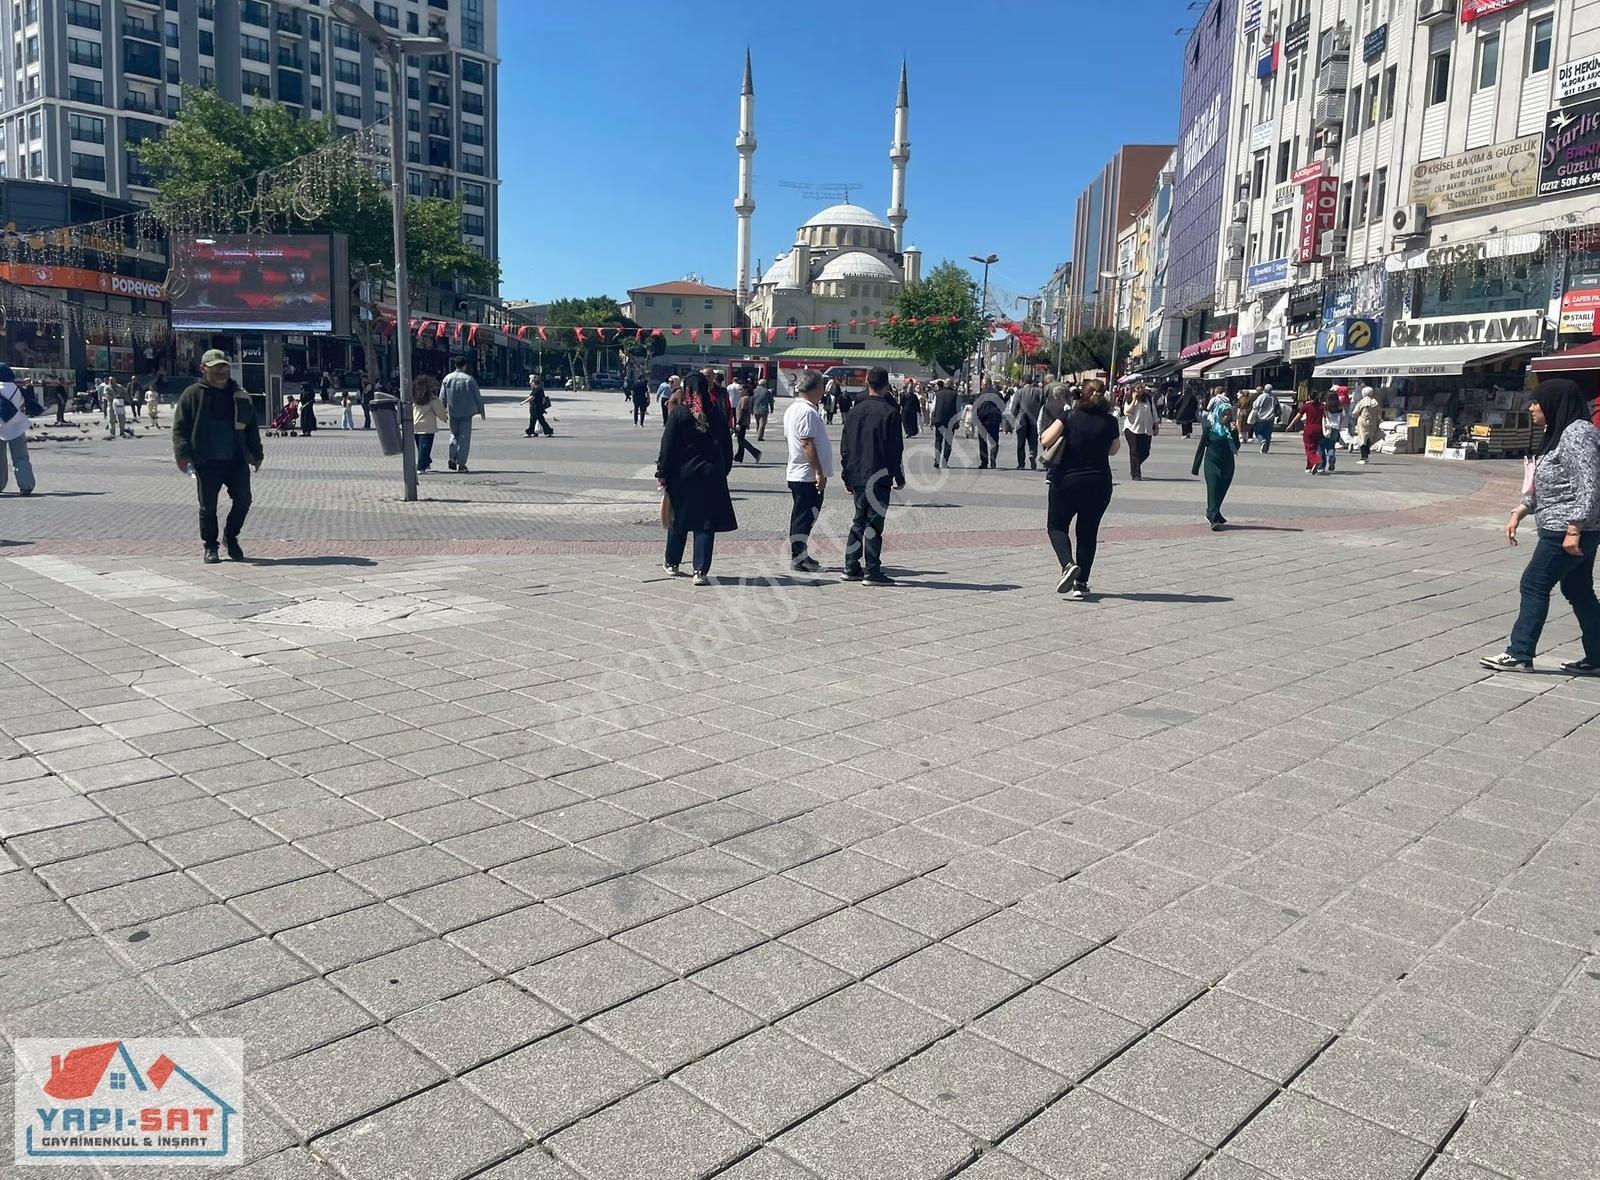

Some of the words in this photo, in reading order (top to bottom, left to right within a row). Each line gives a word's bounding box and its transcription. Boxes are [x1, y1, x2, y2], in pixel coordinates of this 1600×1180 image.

[1560, 65, 1572, 80] DİŞ
[1428, 161, 1454, 175] KİŞİSEL
[1487, 151, 1493, 159] &
[1496, 140, 1537, 158] GÜZELLİK
[1541, 180, 1560, 191] 0212
[1579, 173, 1590, 184] 66
[1302, 200, 1313, 258] NOTER
[1427, 242, 1487, 266] emsan
[111, 277, 161, 298] POPEYES
[1393, 321, 1421, 347] ÖZ
[1423, 319, 1485, 344] MERT
[1485, 315, 1538, 342] AVM
[1408, 366, 1432, 374] ÖZMERT
